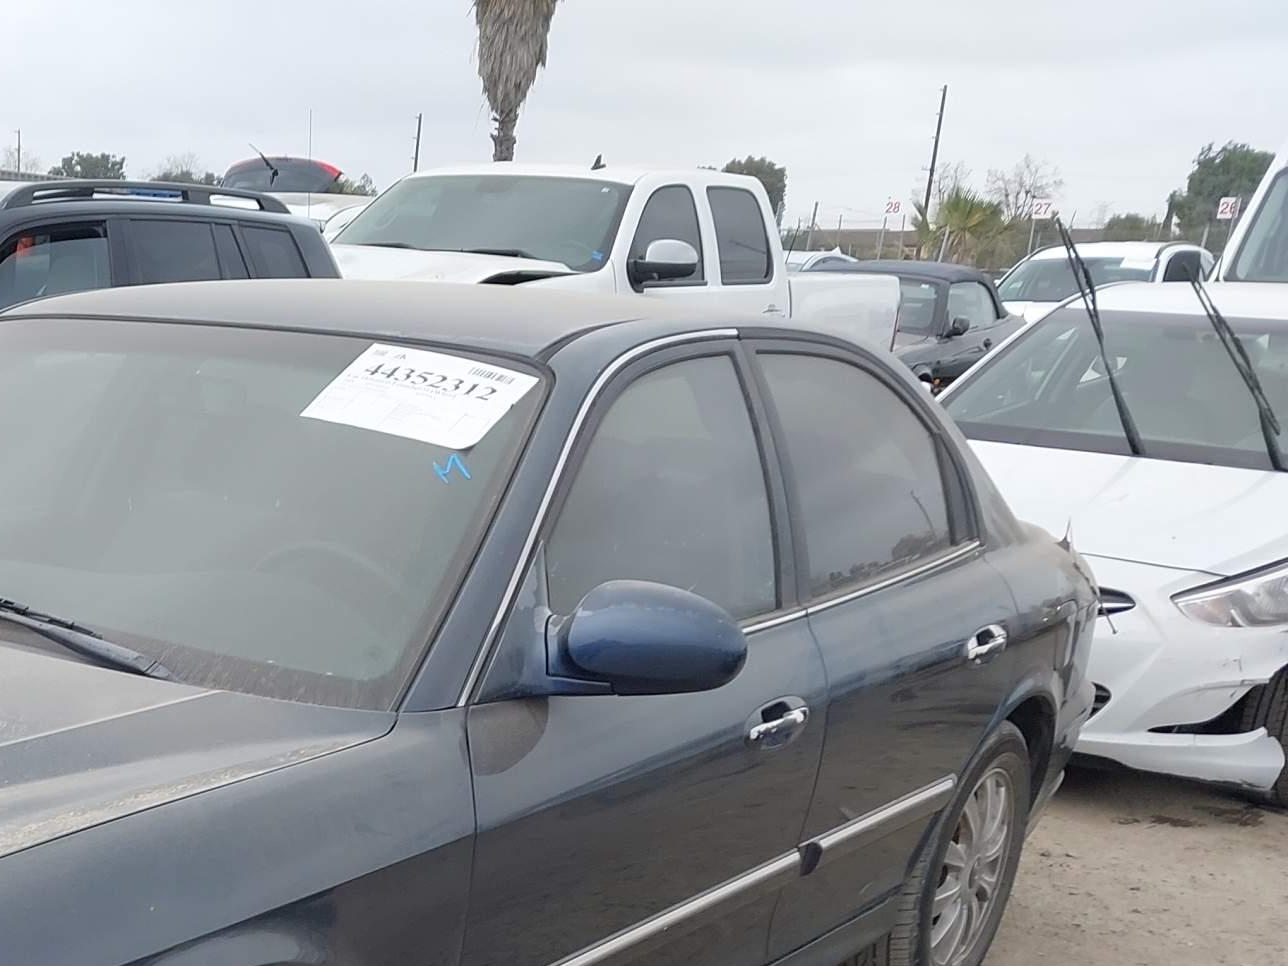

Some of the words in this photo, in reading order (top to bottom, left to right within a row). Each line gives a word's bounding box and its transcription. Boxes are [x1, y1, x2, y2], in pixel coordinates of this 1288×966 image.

[885, 201, 901, 214] 28
[1034, 202, 1052, 215] 27
[365, 362, 498, 401] 44352312
